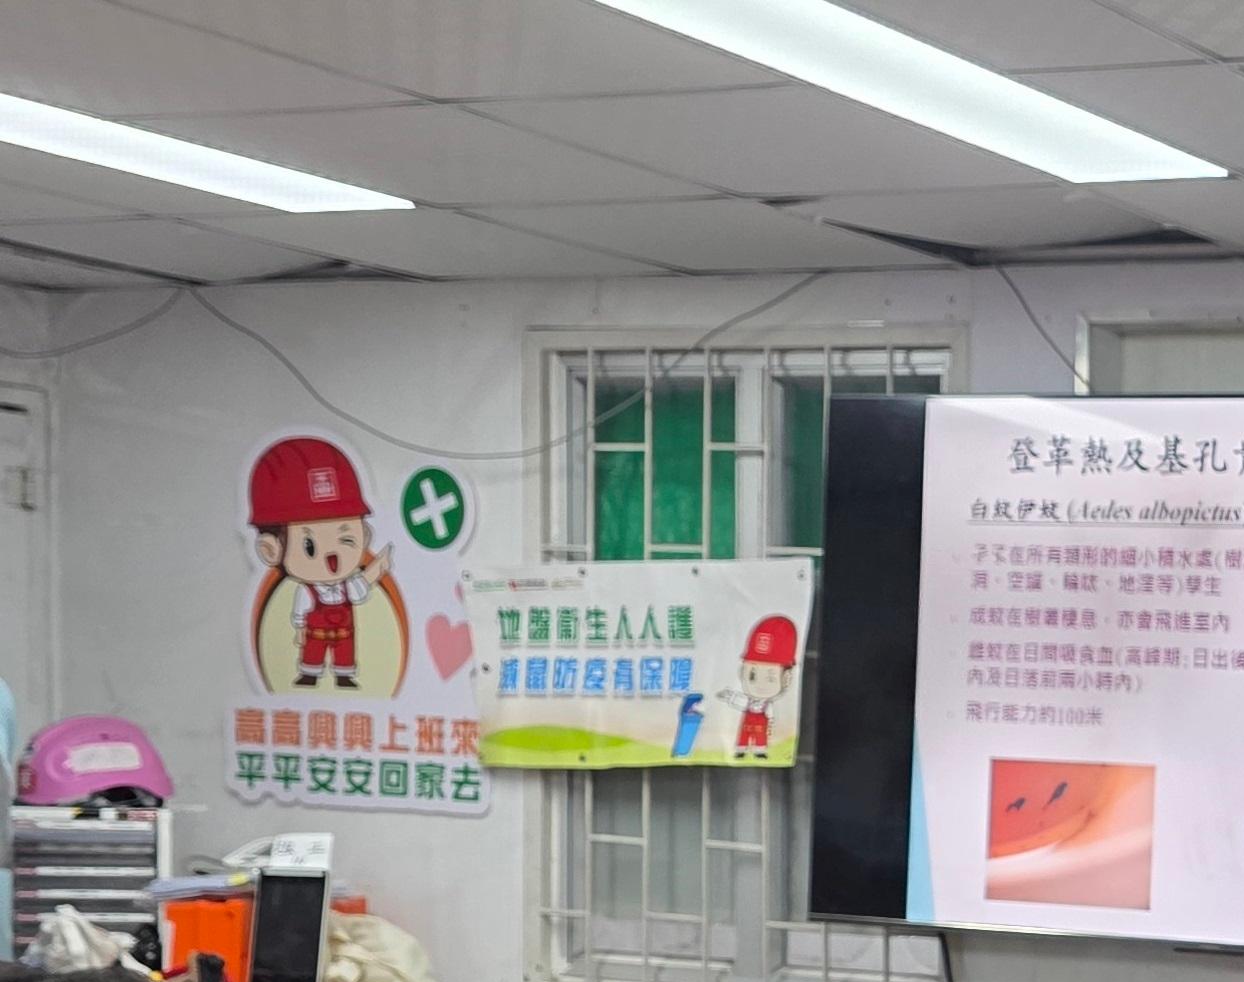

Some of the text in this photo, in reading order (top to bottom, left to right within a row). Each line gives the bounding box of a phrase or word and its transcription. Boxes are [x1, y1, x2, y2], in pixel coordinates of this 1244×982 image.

[235, 752, 481, 802] 平平安安回家去
